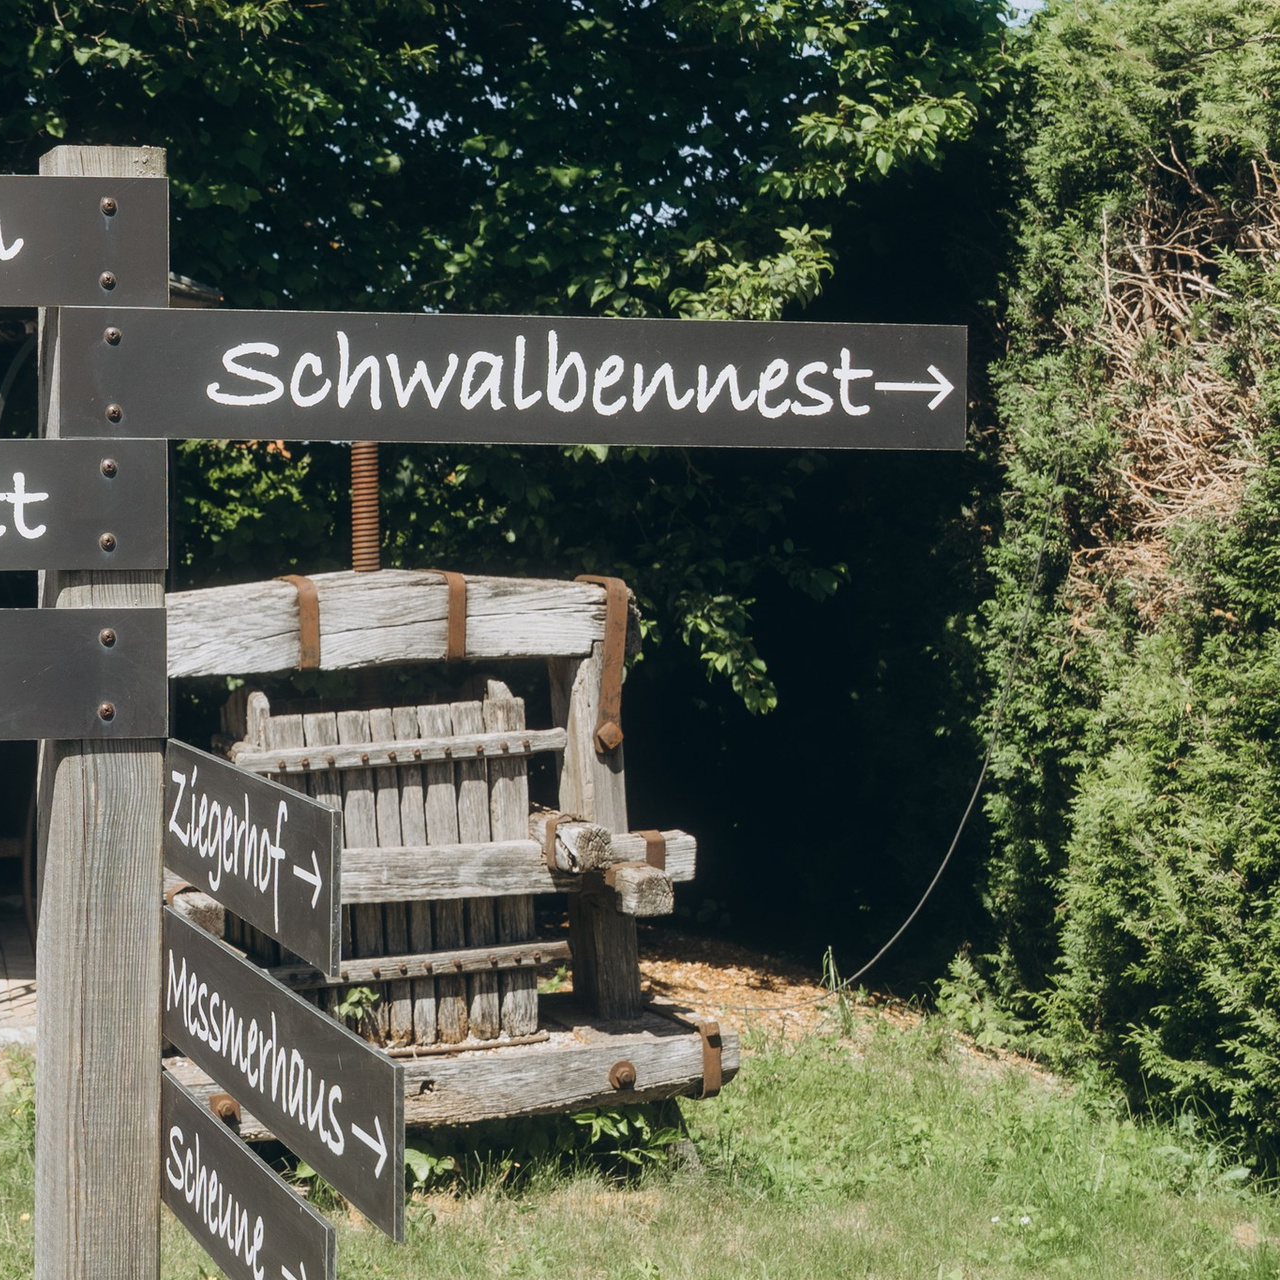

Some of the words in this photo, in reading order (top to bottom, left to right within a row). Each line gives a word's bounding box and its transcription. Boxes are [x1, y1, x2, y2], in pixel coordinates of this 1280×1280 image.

[206, 329, 875, 420] Schwalbennest
[169, 765, 288, 934] Ziegerhof
[166, 948, 345, 1156] Messmerhaus
